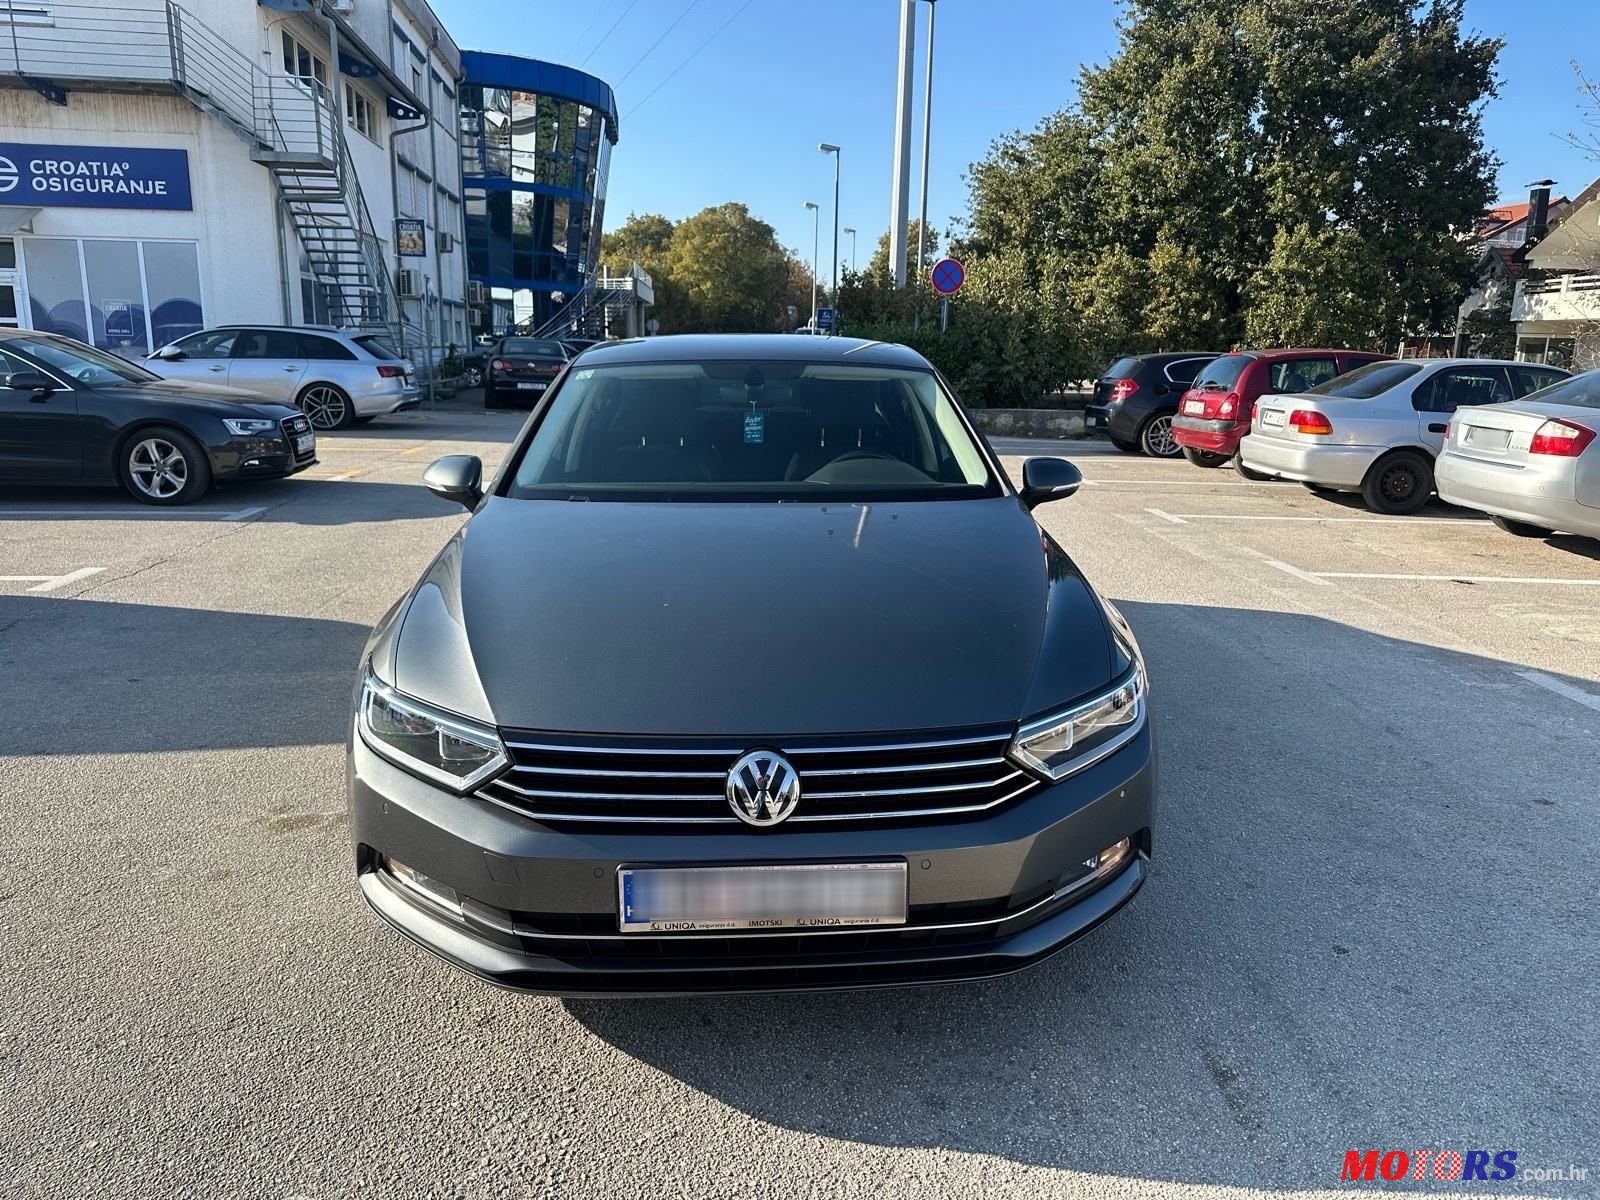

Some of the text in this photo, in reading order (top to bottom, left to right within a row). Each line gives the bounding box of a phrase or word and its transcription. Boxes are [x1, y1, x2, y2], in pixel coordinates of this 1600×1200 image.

[31, 176, 168, 195] OSIGURANJE
[664, 922, 697, 930] UNIQA
[748, 919, 783, 927] IMOTSKI
[809, 917, 841, 925] UNIQA
